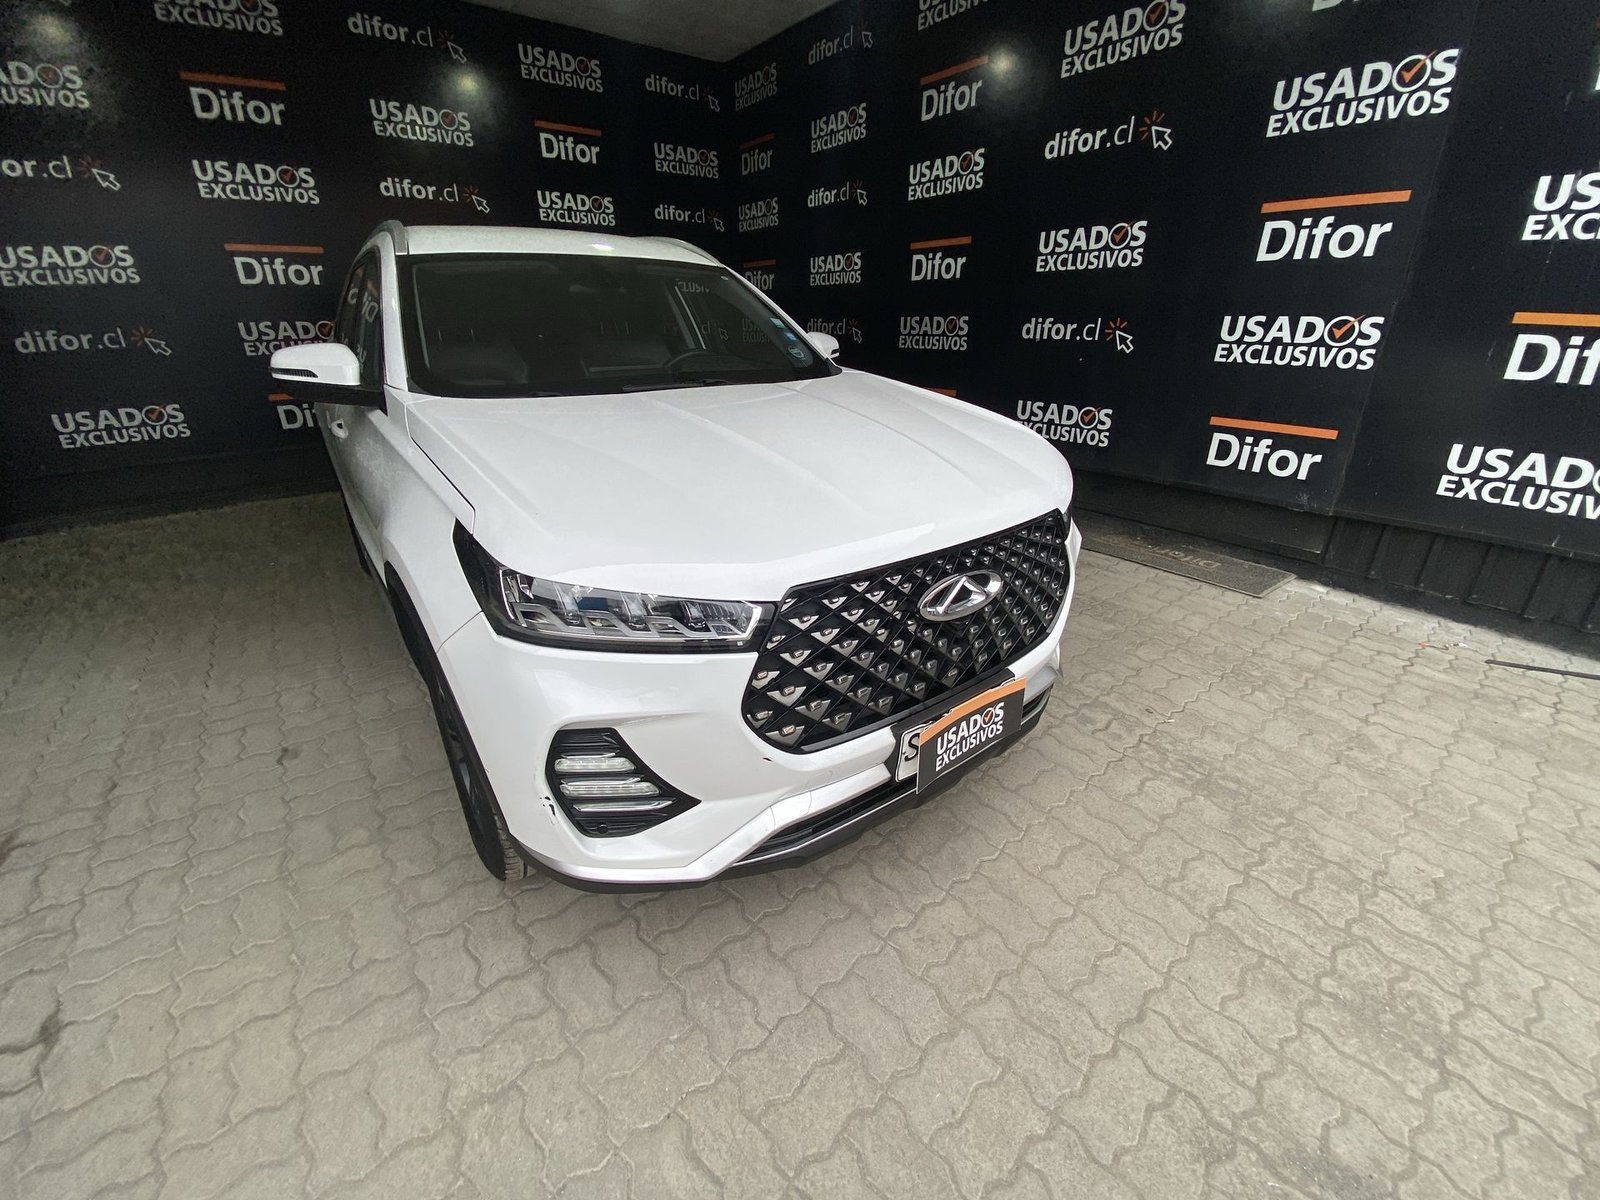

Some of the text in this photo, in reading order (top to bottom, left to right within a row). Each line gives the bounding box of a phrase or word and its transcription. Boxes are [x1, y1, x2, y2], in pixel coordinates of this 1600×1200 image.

[153, 2, 284, 36] EXCLUSIVOS
[347, 12, 434, 47] difor.cl
[1063, 0, 1186, 56] USADOS
[808, 24, 853, 66] difor.cl
[1060, 23, 1184, 79] EXCLUSIVOS
[517, 42, 601, 79] USADOS
[0, 61, 83, 90] DOS
[521, 64, 603, 93] EXCLUSIVOS
[645, 74, 699, 101] difor.cl
[734, 62, 777, 98] USADOS
[1273, 48, 1459, 110] USADOS
[0, 86, 90, 109] USIVOS
[189, 86, 286, 126] Difor
[735, 80, 777, 112] EXCLUSIVOS
[920, 80, 982, 122] Difor
[368, 98, 470, 132] USADOS
[811, 102, 867, 139] USADOS
[1266, 87, 1452, 138] EXCLUSIVOS
[373, 120, 474, 148] EXCLUSIVOS
[539, 132, 600, 165] Difor
[810, 123, 867, 154] EXCLUSIVOS
[1044, 115, 1135, 160] difor.cl
[1, 155, 72, 178] or.cl
[654, 142, 718, 167] USADOS
[741, 149, 773, 176] Difor
[908, 147, 985, 185] USADOS
[192, 159, 315, 188] USADOS
[655, 159, 719, 180] EXCLUSIVOS
[198, 182, 320, 205] EXCLUSIVOS
[379, 177, 459, 203] difor.cl
[807, 181, 849, 208] difor.cl
[907, 172, 984, 201] EXCLUSIVOS
[536, 190, 614, 214] USADOS
[654, 204, 705, 224] difor.cl
[738, 197, 778, 221] USADOS
[539, 208, 616, 227] EXCLUSIVOS
[738, 213, 779, 233] EXCLUSIVOS
[1038, 220, 1148, 254] USADOS
[1256, 215, 1393, 262] Difor
[0, 245, 134, 269] USADOS
[234, 256, 323, 286] Difor
[810, 252, 862, 274] USADOS
[911, 251, 966, 281] Difor
[1036, 248, 1144, 273] EXCLUSIVOS
[0, 267, 140, 287] EXCLUSIVOS
[809, 270, 862, 287] EXCLUSIVOS
[14, 327, 126, 354] difor.cl
[237, 321, 335, 340] USADO
[900, 315, 969, 337] USADOS
[1021, 317, 1101, 341] difor.cl
[1220, 314, 1385, 348] USADOS
[899, 334, 968, 351] EXCLUSIVOS
[1213, 343, 1376, 370] EXCLUSIVOS
[1503, 333, 1600, 386] Dif
[51, 404, 185, 433] USADOS
[1016, 399, 1113, 430] USADOS
[58, 423, 191, 449] EXCLUSIVOS
[1205, 432, 1323, 481] Difor
[1446, 443, 1600, 495] USAD
[1436, 474, 1600, 520] EXCLUSIV
[936, 702, 1004, 755] USADOS
[935, 721, 1004, 772] EXCLUSIVOS
